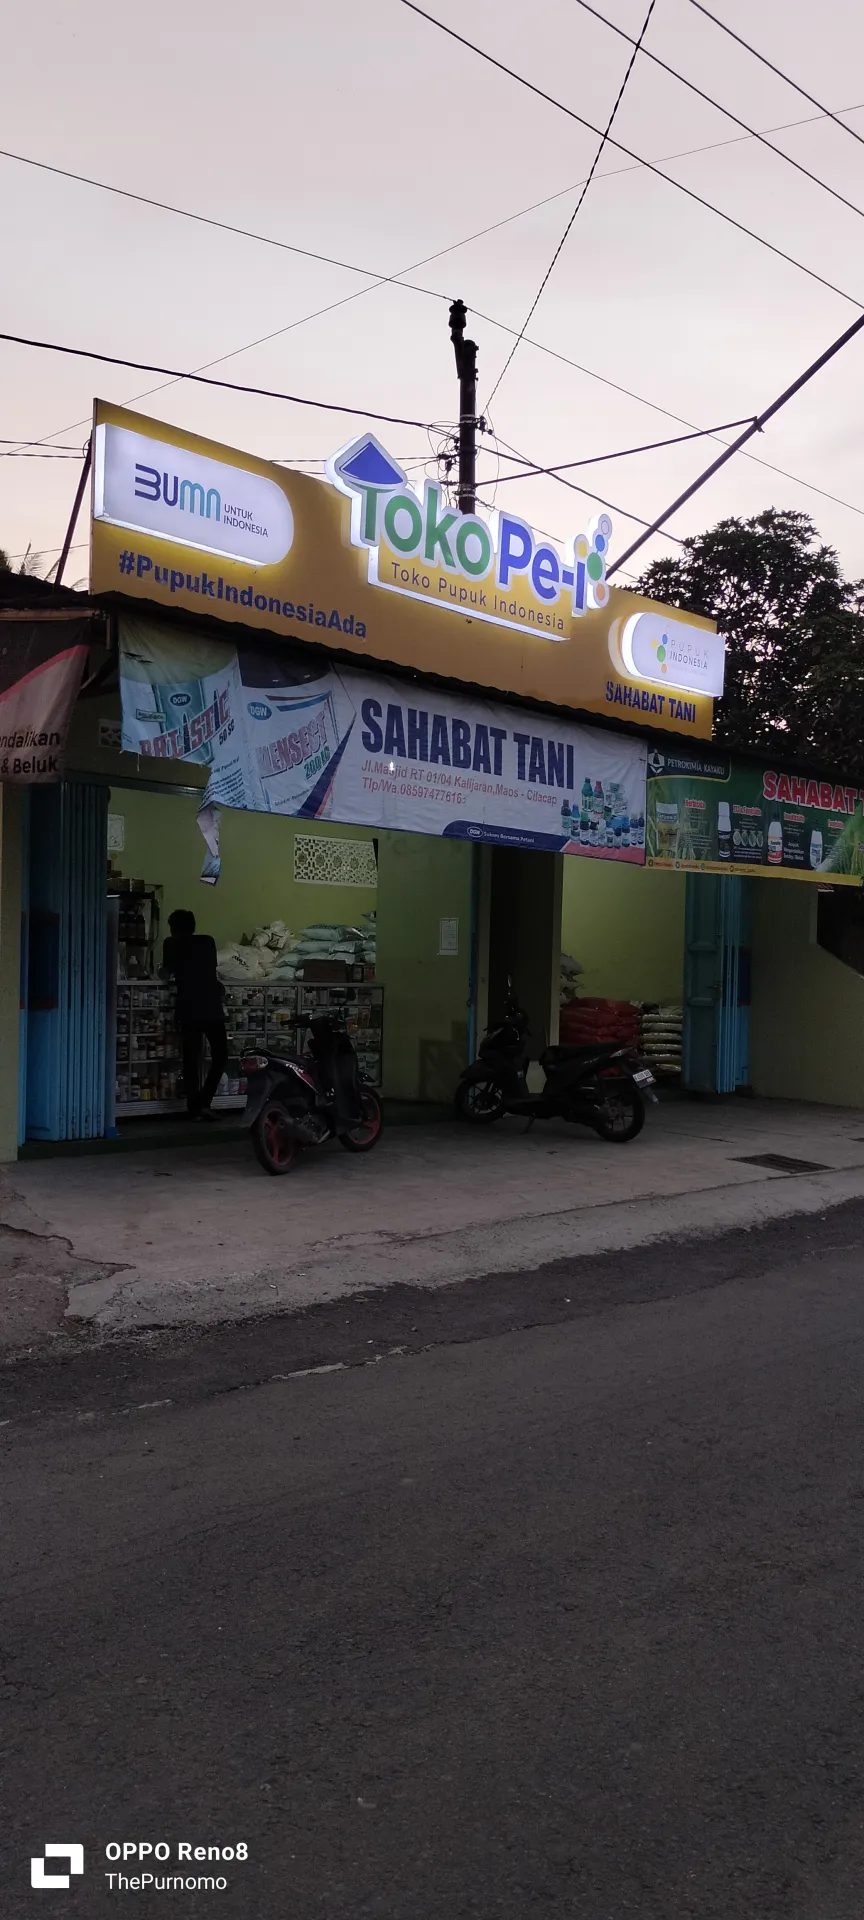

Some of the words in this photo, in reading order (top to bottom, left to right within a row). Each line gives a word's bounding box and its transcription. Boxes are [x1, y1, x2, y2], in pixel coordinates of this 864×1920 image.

[224, 503, 254, 521] UNTUK
[223, 514, 269, 538] INDONESIA
[347, 480, 491, 576] Toko
[119, 550, 367, 638] #PupukIndonesiaAda
[391, 561, 430, 589] Toko
[438, 577, 487, 607] Pupuk
[493, 593, 565, 631] Indonesia
[670, 650, 708, 671] INDONESIA
[671, 639, 709, 659] PUPUK
[250, 705, 268, 718] DGW
[605, 681, 666, 716] SAHABAT
[669, 698, 696, 723] TANI
[0, 731, 61, 748] ndalikan
[361, 698, 507, 776] SAHABAT
[513, 732, 574, 790] TANI
[1, 757, 9, 773] &
[13, 755, 59, 774] Beluk
[667, 758, 702, 772] PETROKIMIA
[703, 763, 725, 775] KAYAKU
[411, 768, 425, 781] RT
[426, 770, 452, 787] 01/04
[526, 789, 557, 807] Cilacap
[762, 769, 857, 815] SAHABAT
